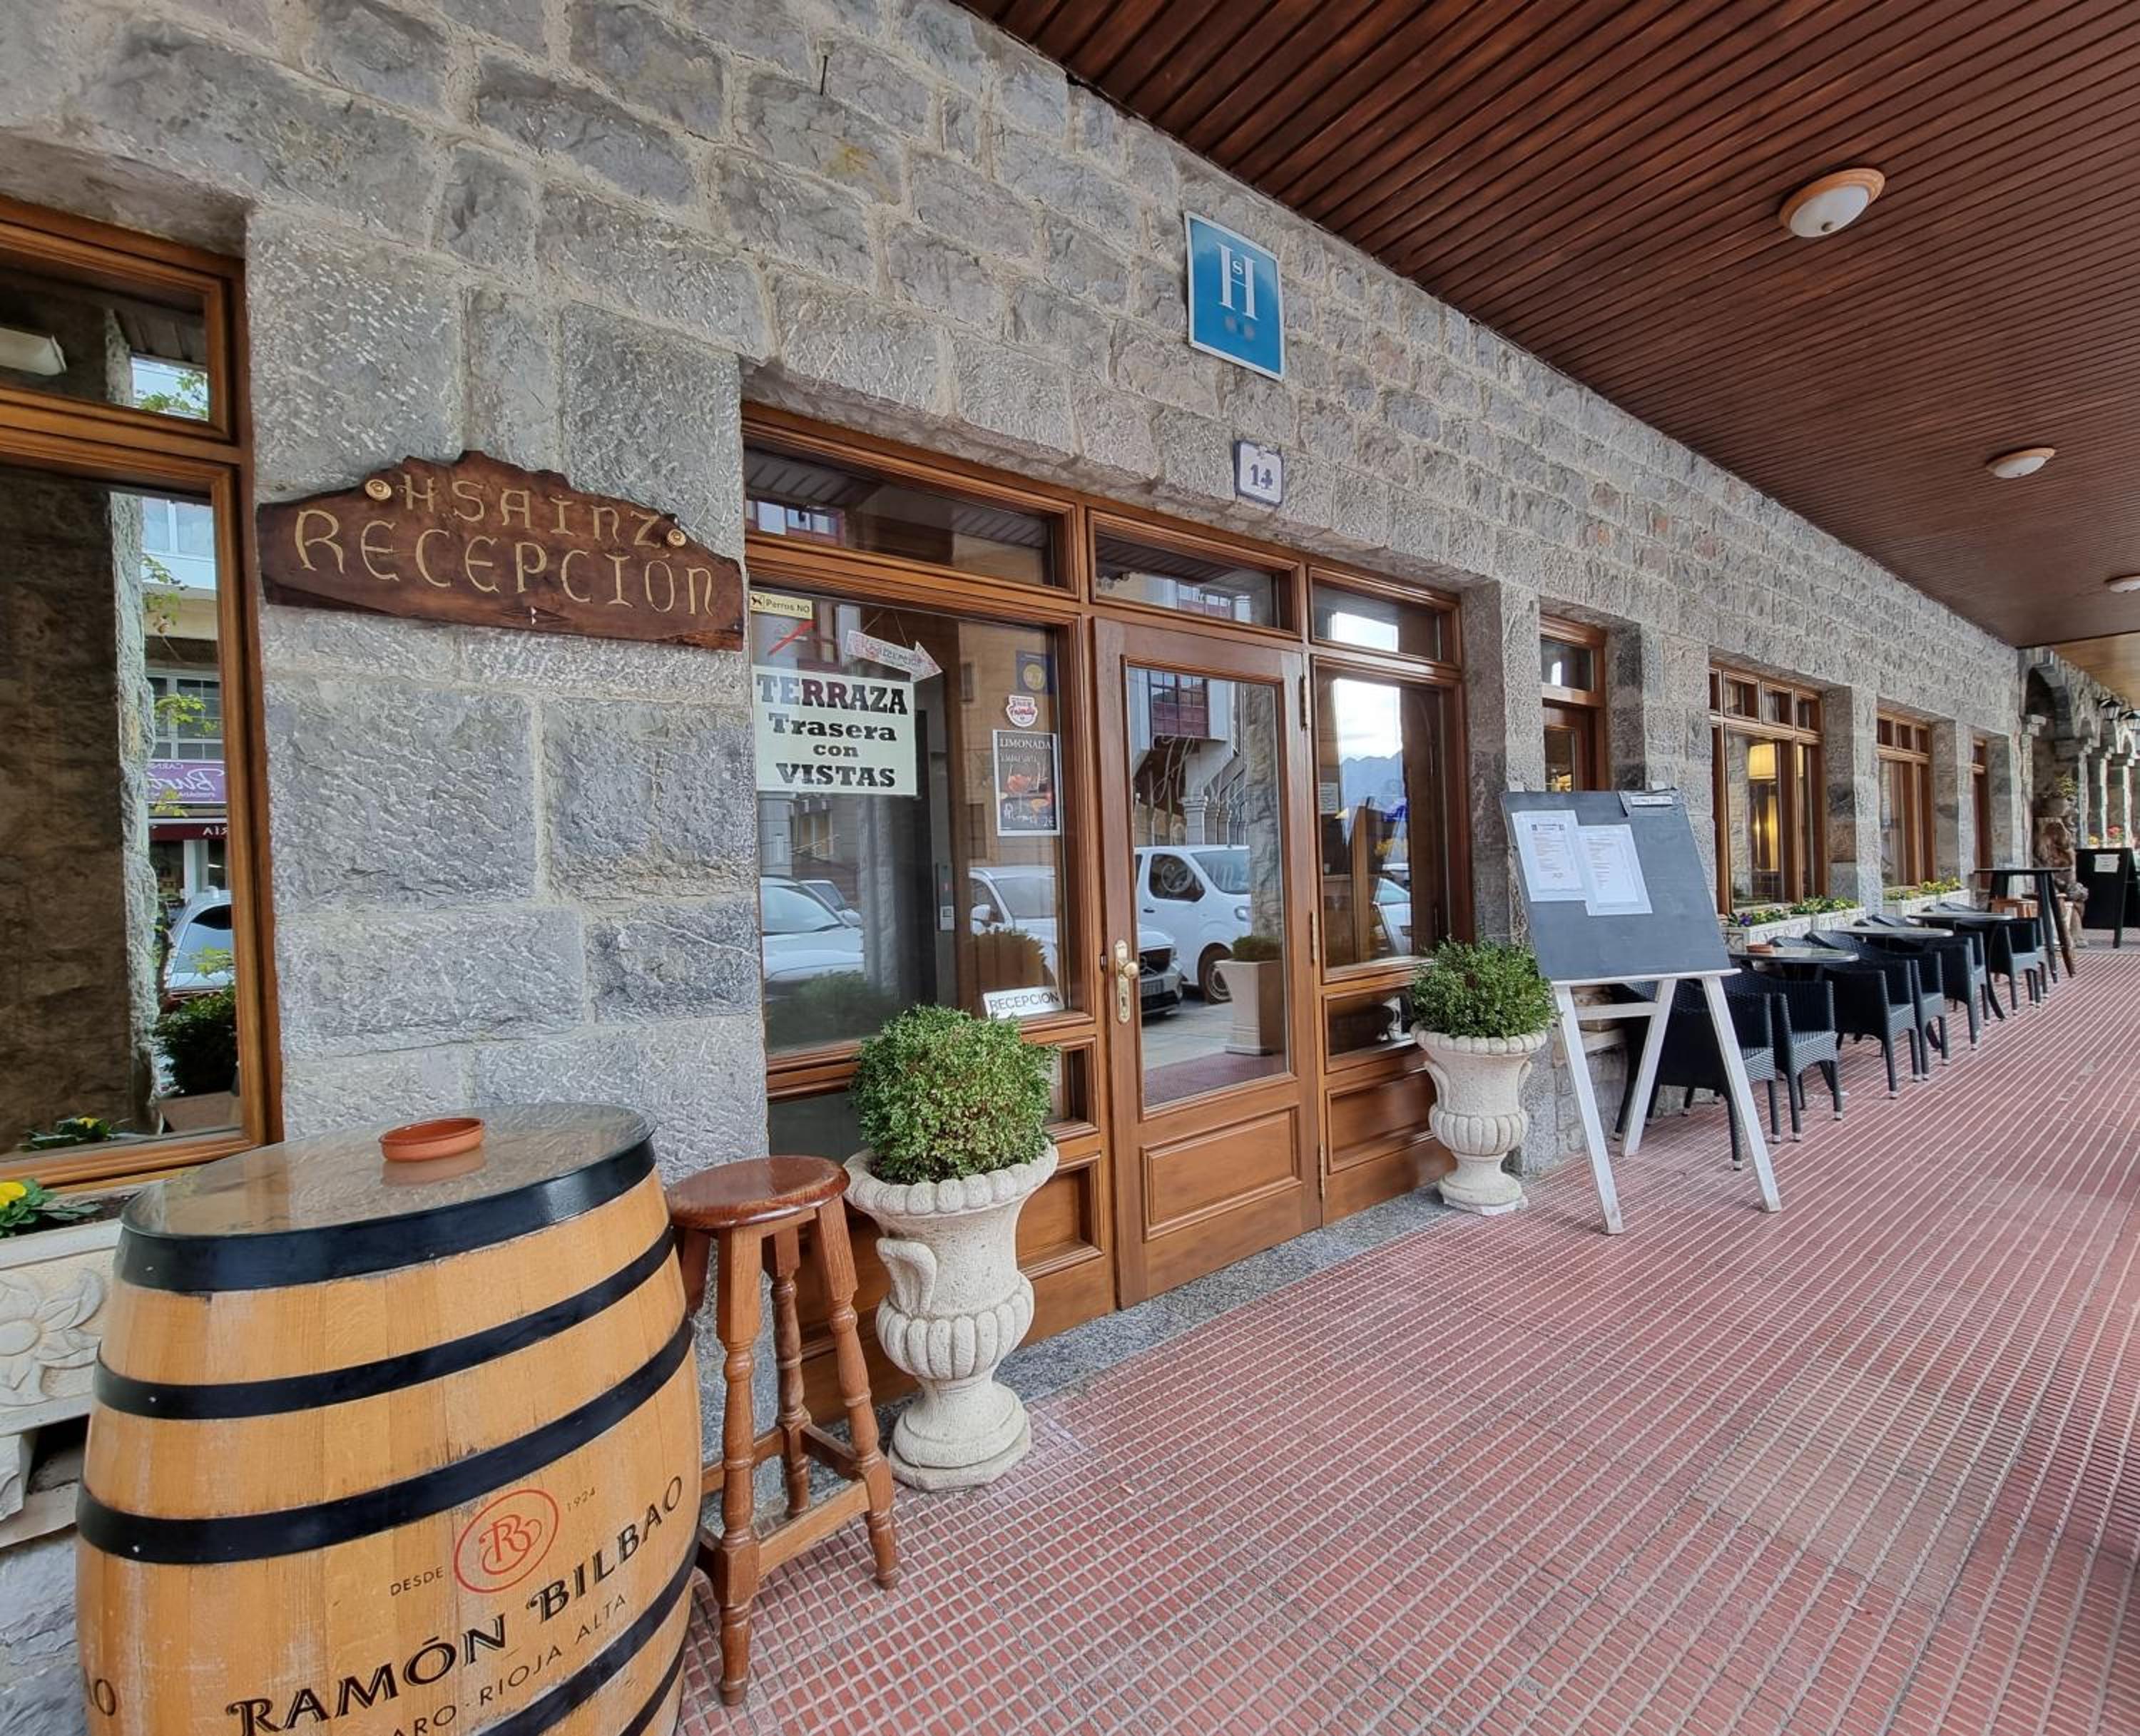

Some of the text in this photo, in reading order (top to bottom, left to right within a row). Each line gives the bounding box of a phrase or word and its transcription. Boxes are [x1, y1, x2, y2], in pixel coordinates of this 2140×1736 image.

[1216, 242, 1260, 321] H
[1250, 464, 1273, 491] 14
[294, 509, 713, 618] RECEPCIÓN
[797, 605, 810, 613] NO
[756, 674, 908, 715] TERRAZA
[768, 713, 897, 742] Trasera
[812, 744, 859, 757] con
[1000, 738, 1052, 750] LIMONADA
[775, 762, 896, 788] VISTAS
[989, 992, 1060, 1012] RECEPCION
[567, 1487, 596, 1513] 1924
[526, 1476, 683, 1623] BILBAO
[389, 1566, 444, 1597] DESDE
[479, 1645, 562, 1707] RIOJA
[574, 1594, 627, 1645] ALTA
